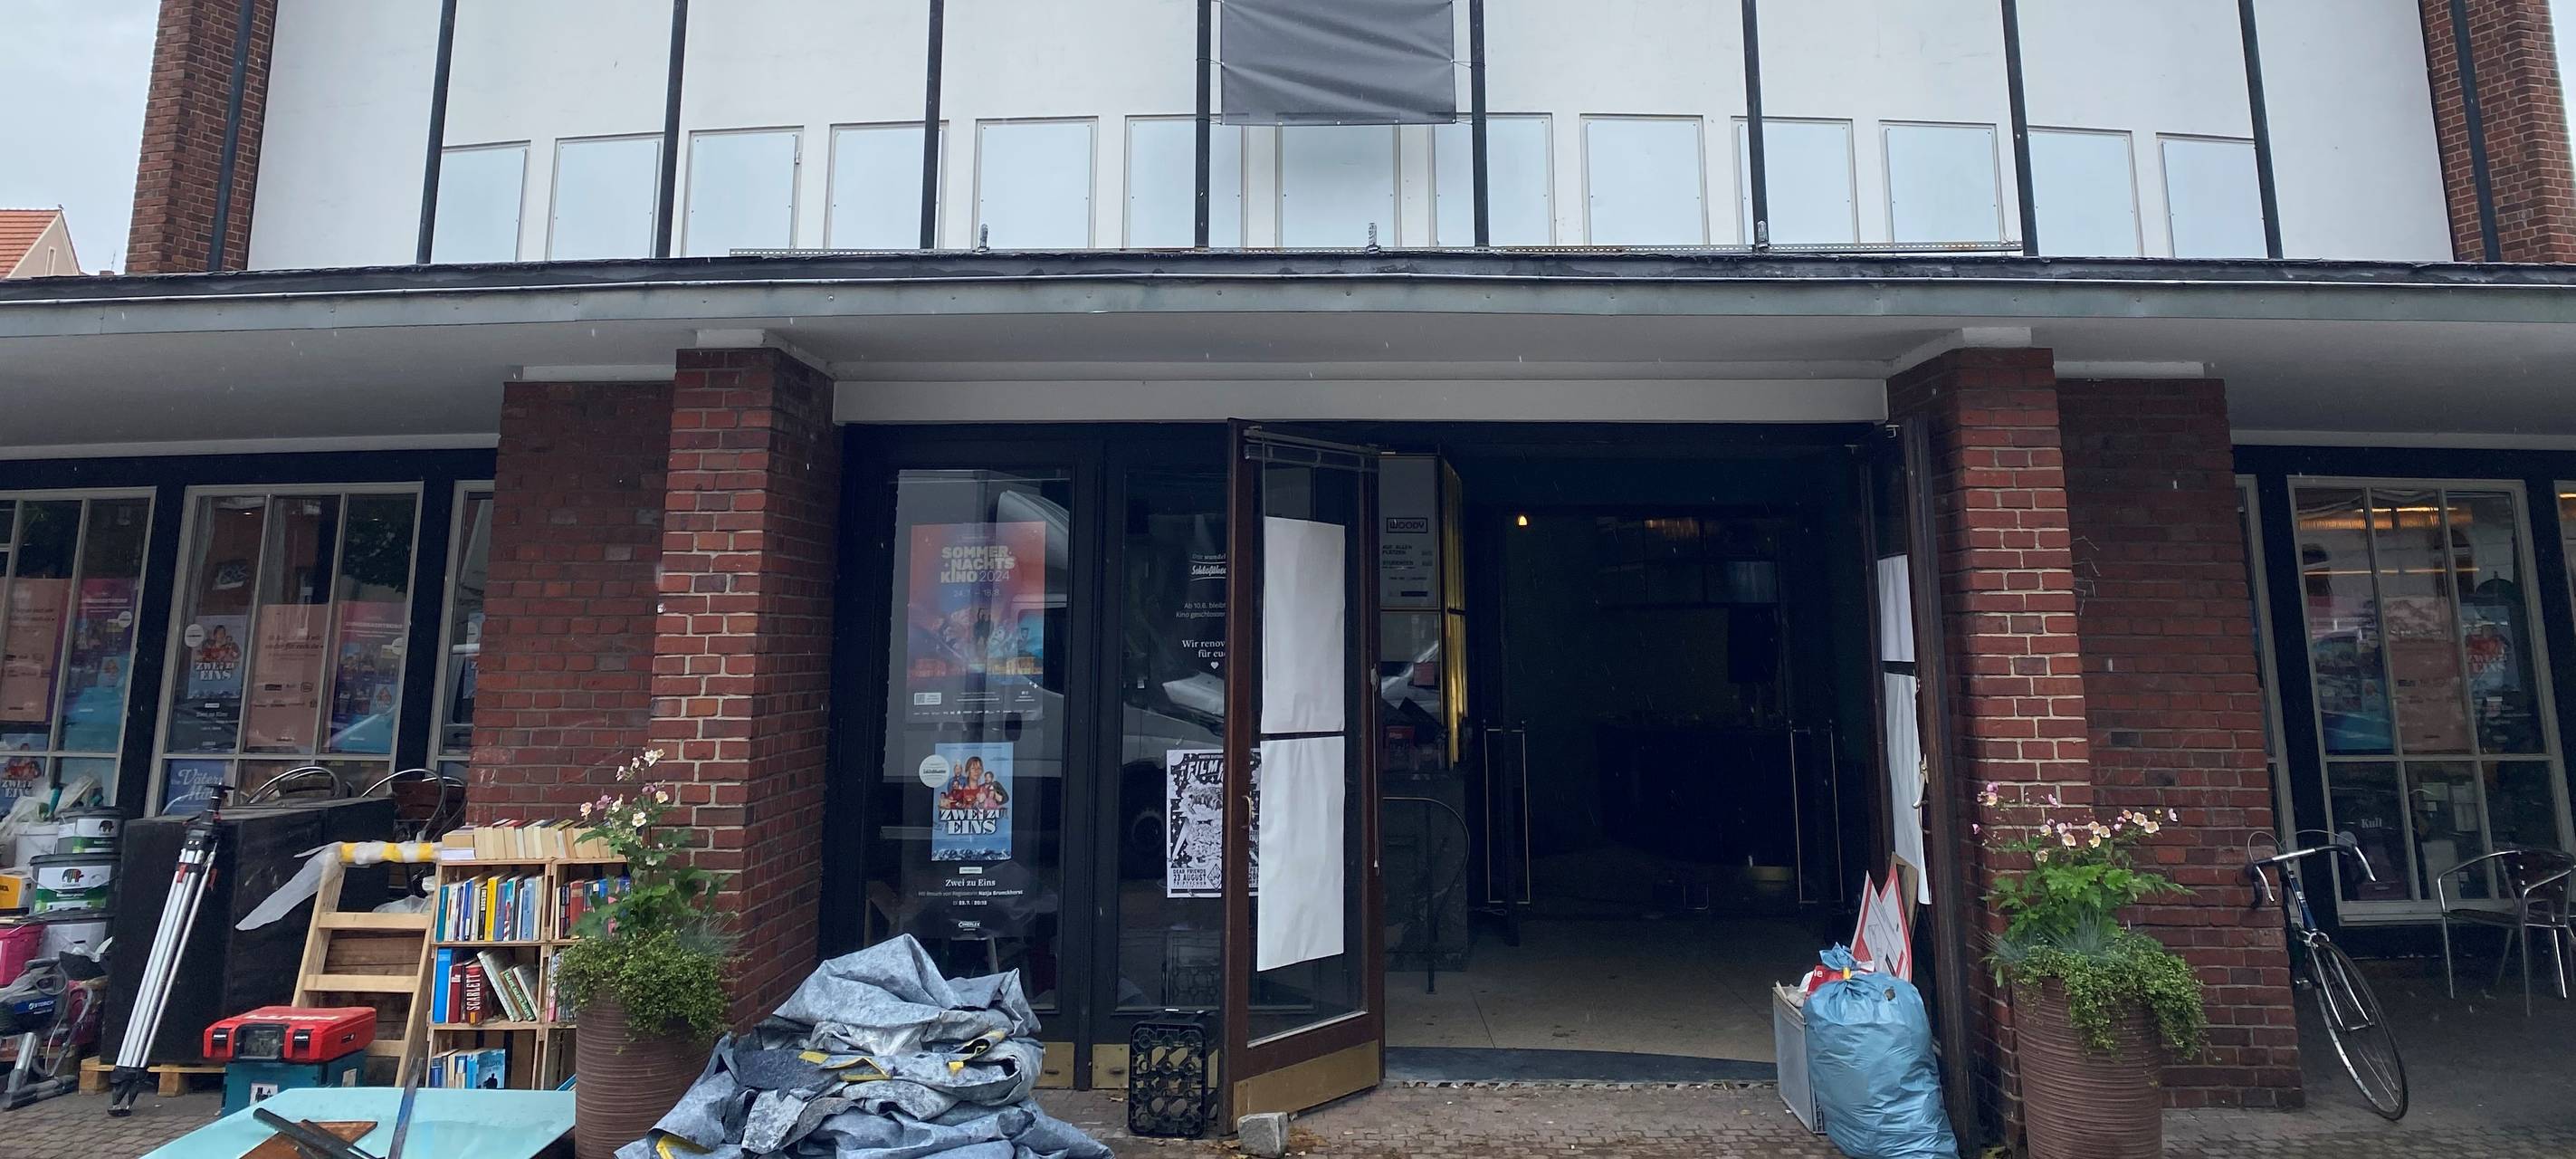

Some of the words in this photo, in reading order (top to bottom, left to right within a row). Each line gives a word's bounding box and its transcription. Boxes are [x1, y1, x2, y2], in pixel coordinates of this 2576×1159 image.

[1389, 520, 1426, 530] WOODY
[941, 545, 1009, 559] SOMMER
[951, 558, 1016, 570] NACHTS
[940, 570, 978, 583] KINO
[978, 570, 1009, 582] 2024
[1182, 639, 1199, 647] Wir
[1198, 649, 1211, 658] für
[200, 670, 232, 680] EINS
[940, 809, 985, 820] ZWEI
[947, 818, 997, 836] EINS
[945, 878, 965, 887] Zwei
[978, 878, 997, 886] Eins
[1173, 874, 1181, 882] 23
[1182, 874, 1207, 882] AUGUST
[465, 973, 482, 1011] SCARLETT
